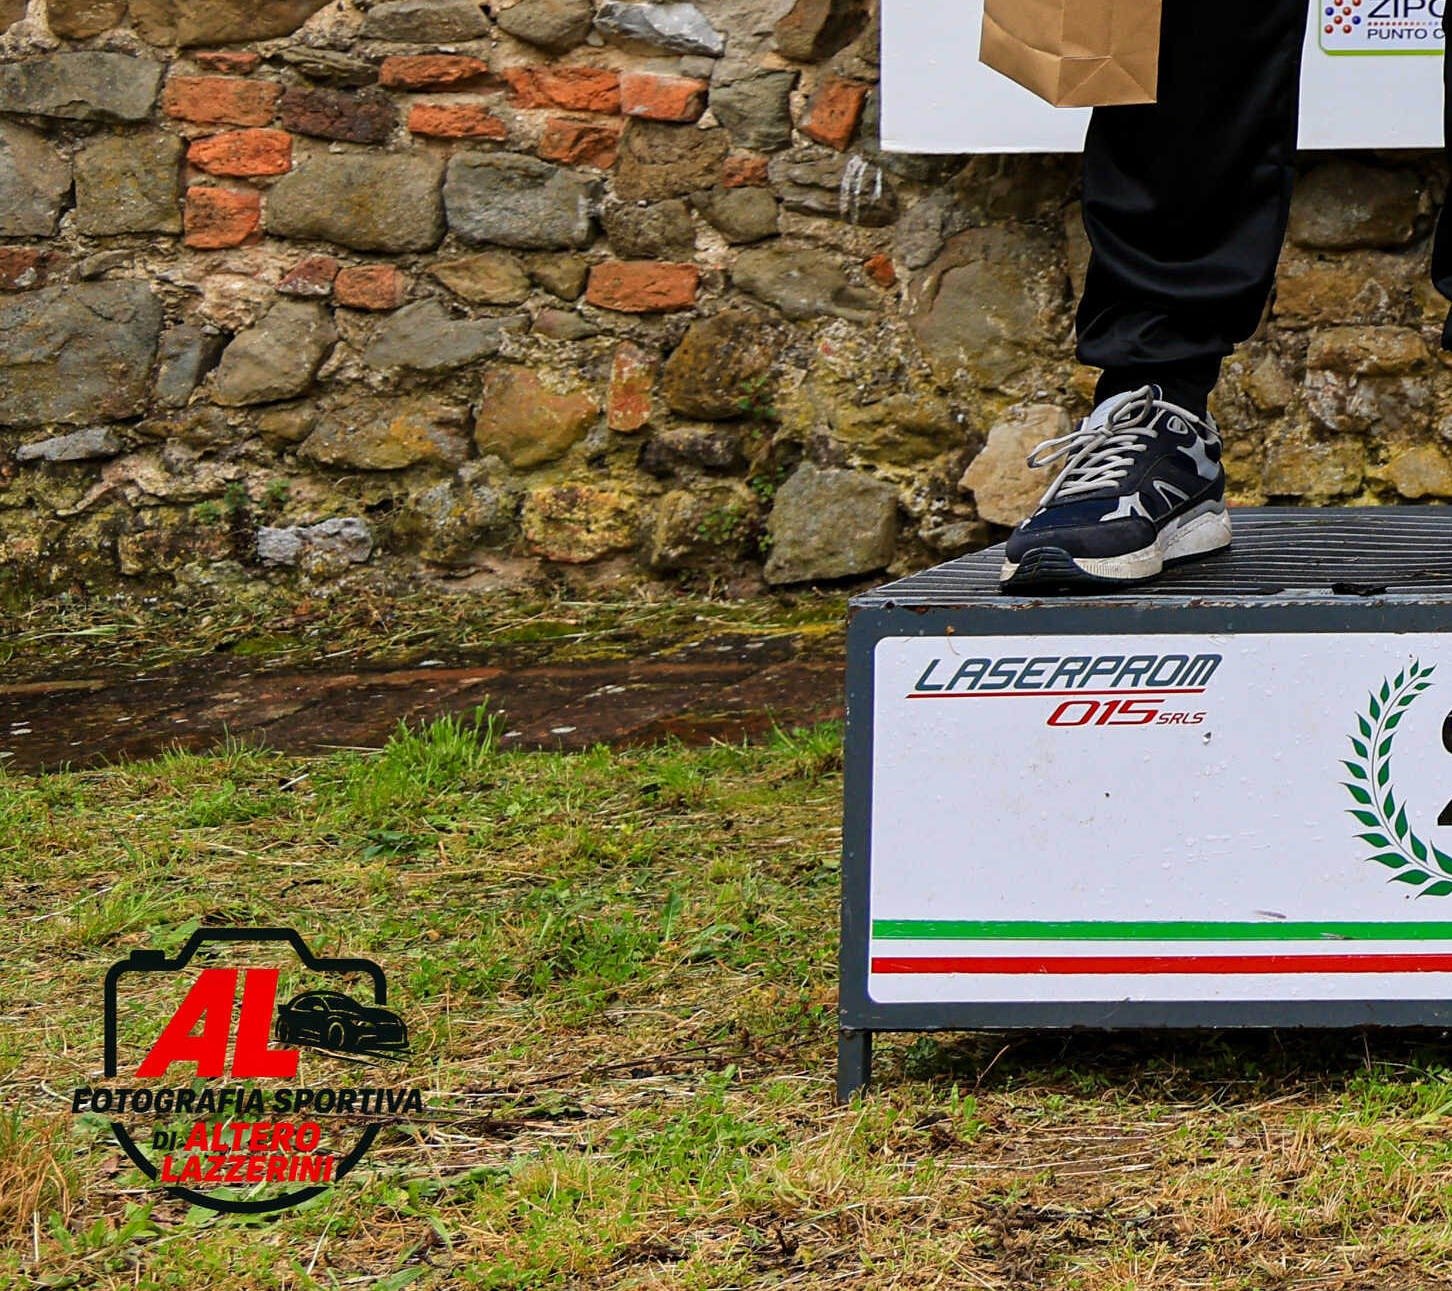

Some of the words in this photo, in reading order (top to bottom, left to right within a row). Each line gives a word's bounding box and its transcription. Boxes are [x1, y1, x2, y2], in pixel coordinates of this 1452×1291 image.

[1367, 28, 1425, 40] PUNTO
[914, 653, 1223, 693] LASERPROM
[1157, 710, 1207, 726] SRLS
